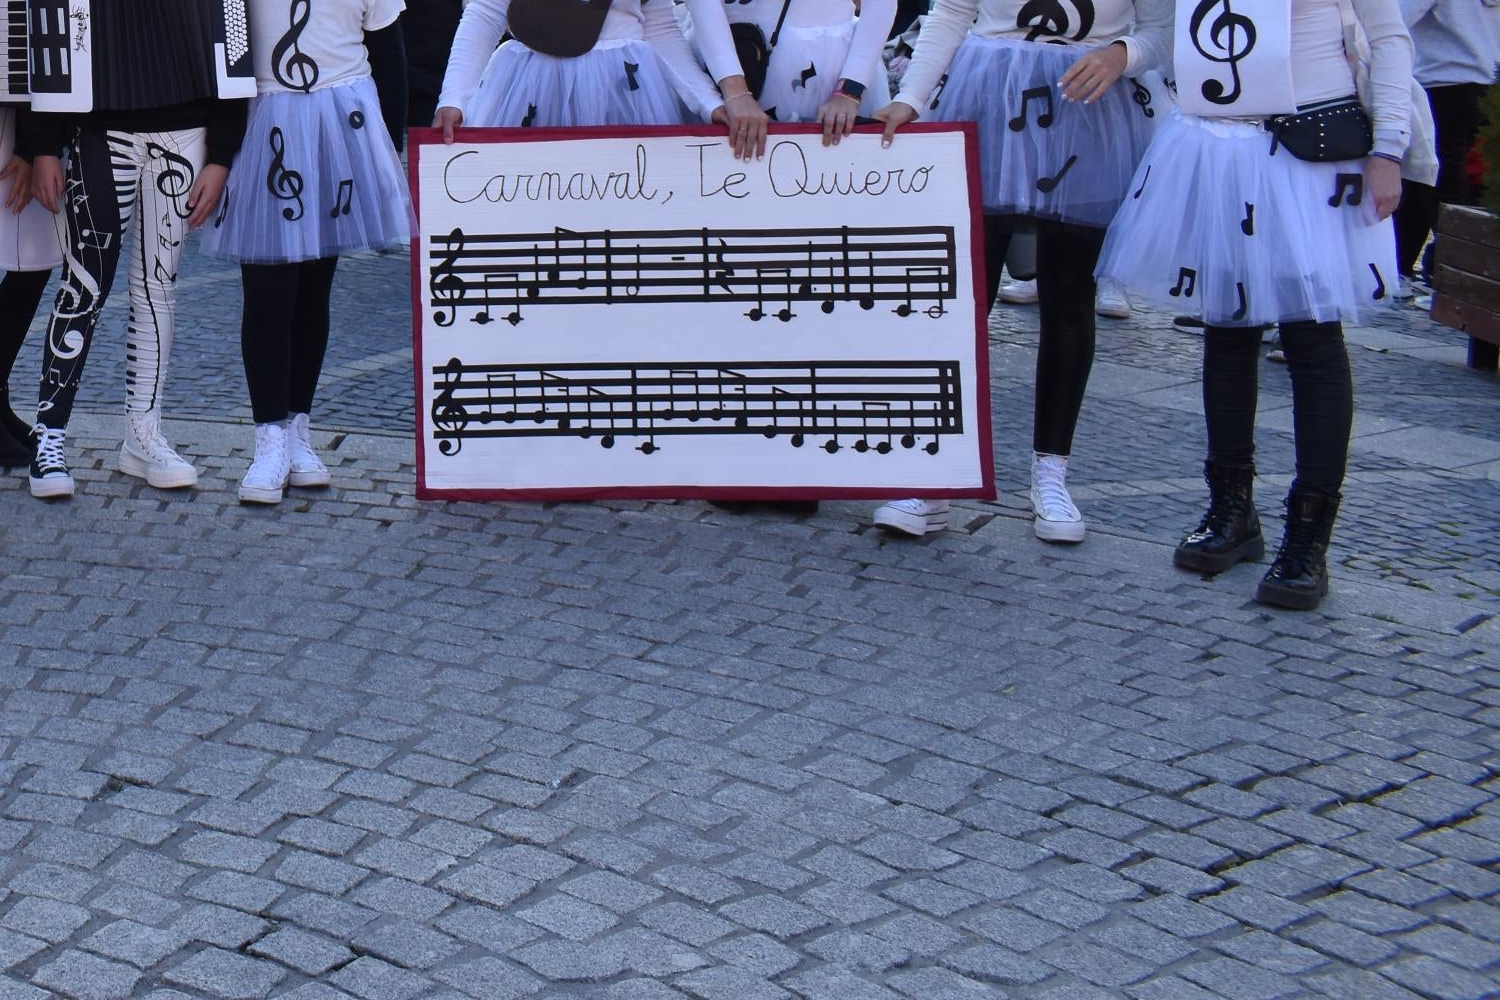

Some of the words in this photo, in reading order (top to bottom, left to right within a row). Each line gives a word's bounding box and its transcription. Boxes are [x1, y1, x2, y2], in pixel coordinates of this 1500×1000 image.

[443, 144, 674, 205] Carnaval,
[685, 142, 750, 199] Te
[768, 140, 935, 198] Quiero
